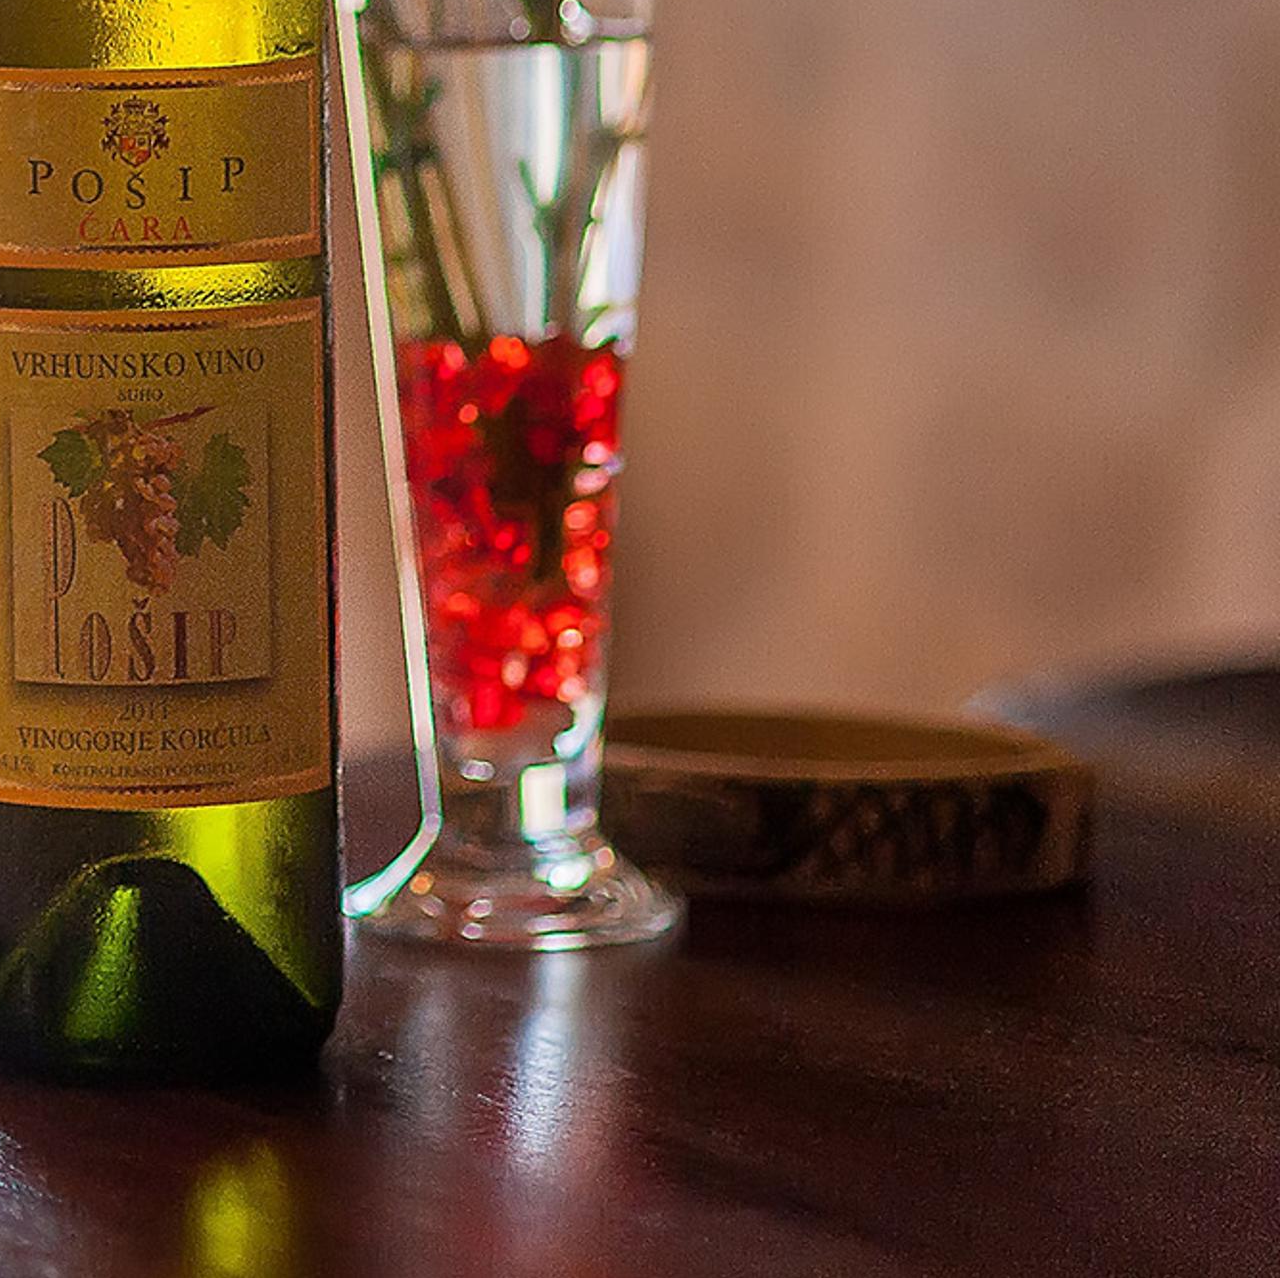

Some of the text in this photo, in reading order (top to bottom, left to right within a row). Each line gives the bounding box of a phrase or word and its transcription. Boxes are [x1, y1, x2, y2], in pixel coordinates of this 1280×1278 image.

[28, 156, 246, 210] POŠIP
[12, 346, 265, 378] VRHUNSKO VINO
[117, 388, 164, 403] SUHO
[44, 497, 237, 682] POŠIP
[17, 726, 154, 755] VINOGORJE
